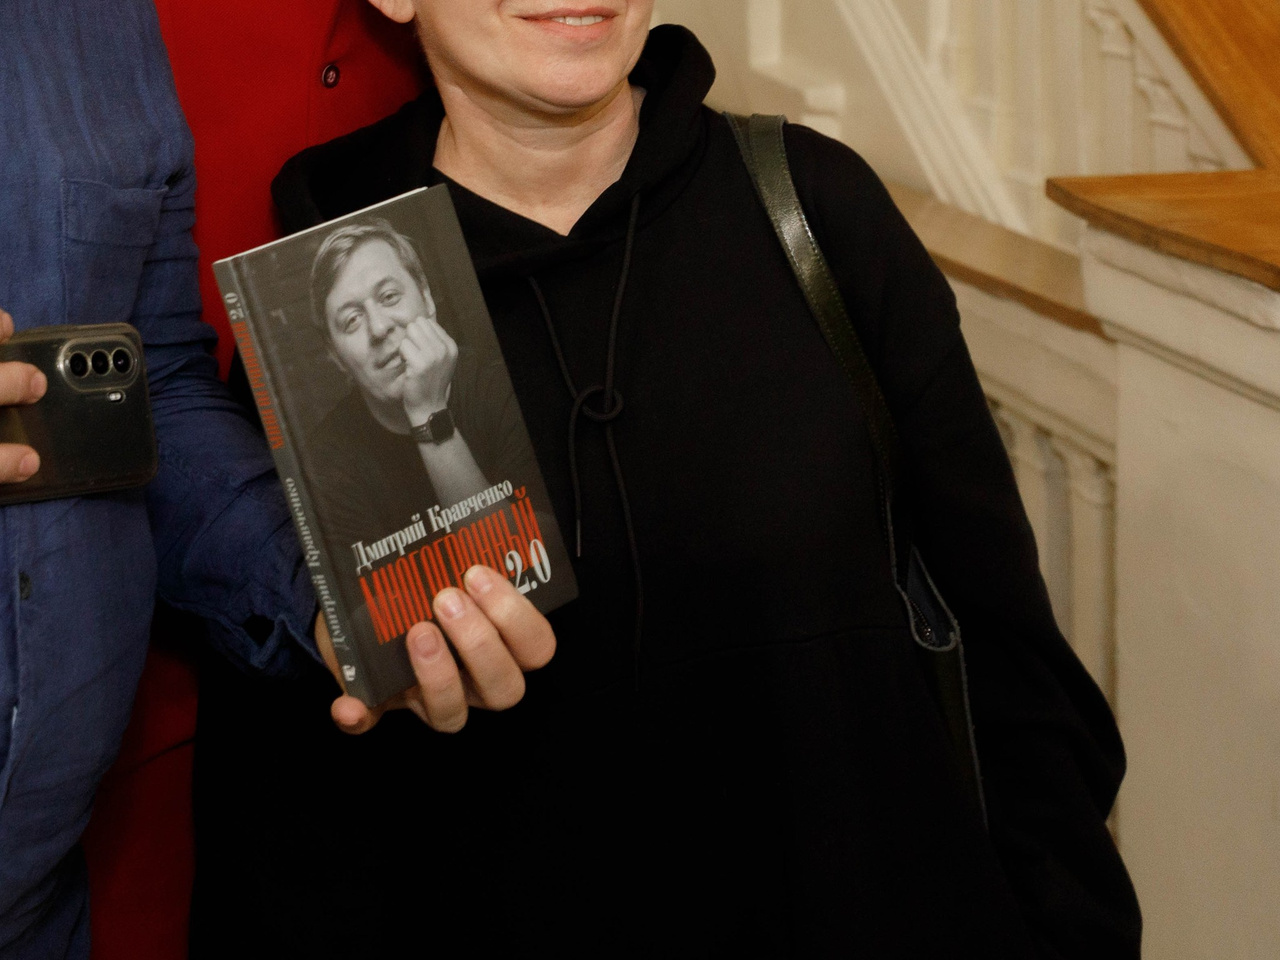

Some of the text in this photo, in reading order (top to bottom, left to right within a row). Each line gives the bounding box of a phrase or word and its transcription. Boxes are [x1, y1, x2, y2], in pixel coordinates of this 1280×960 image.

[224, 292, 245, 320] 2.0
[351, 479, 514, 577] Дмитрий Кравченко
[504, 538, 552, 596] 2.0
